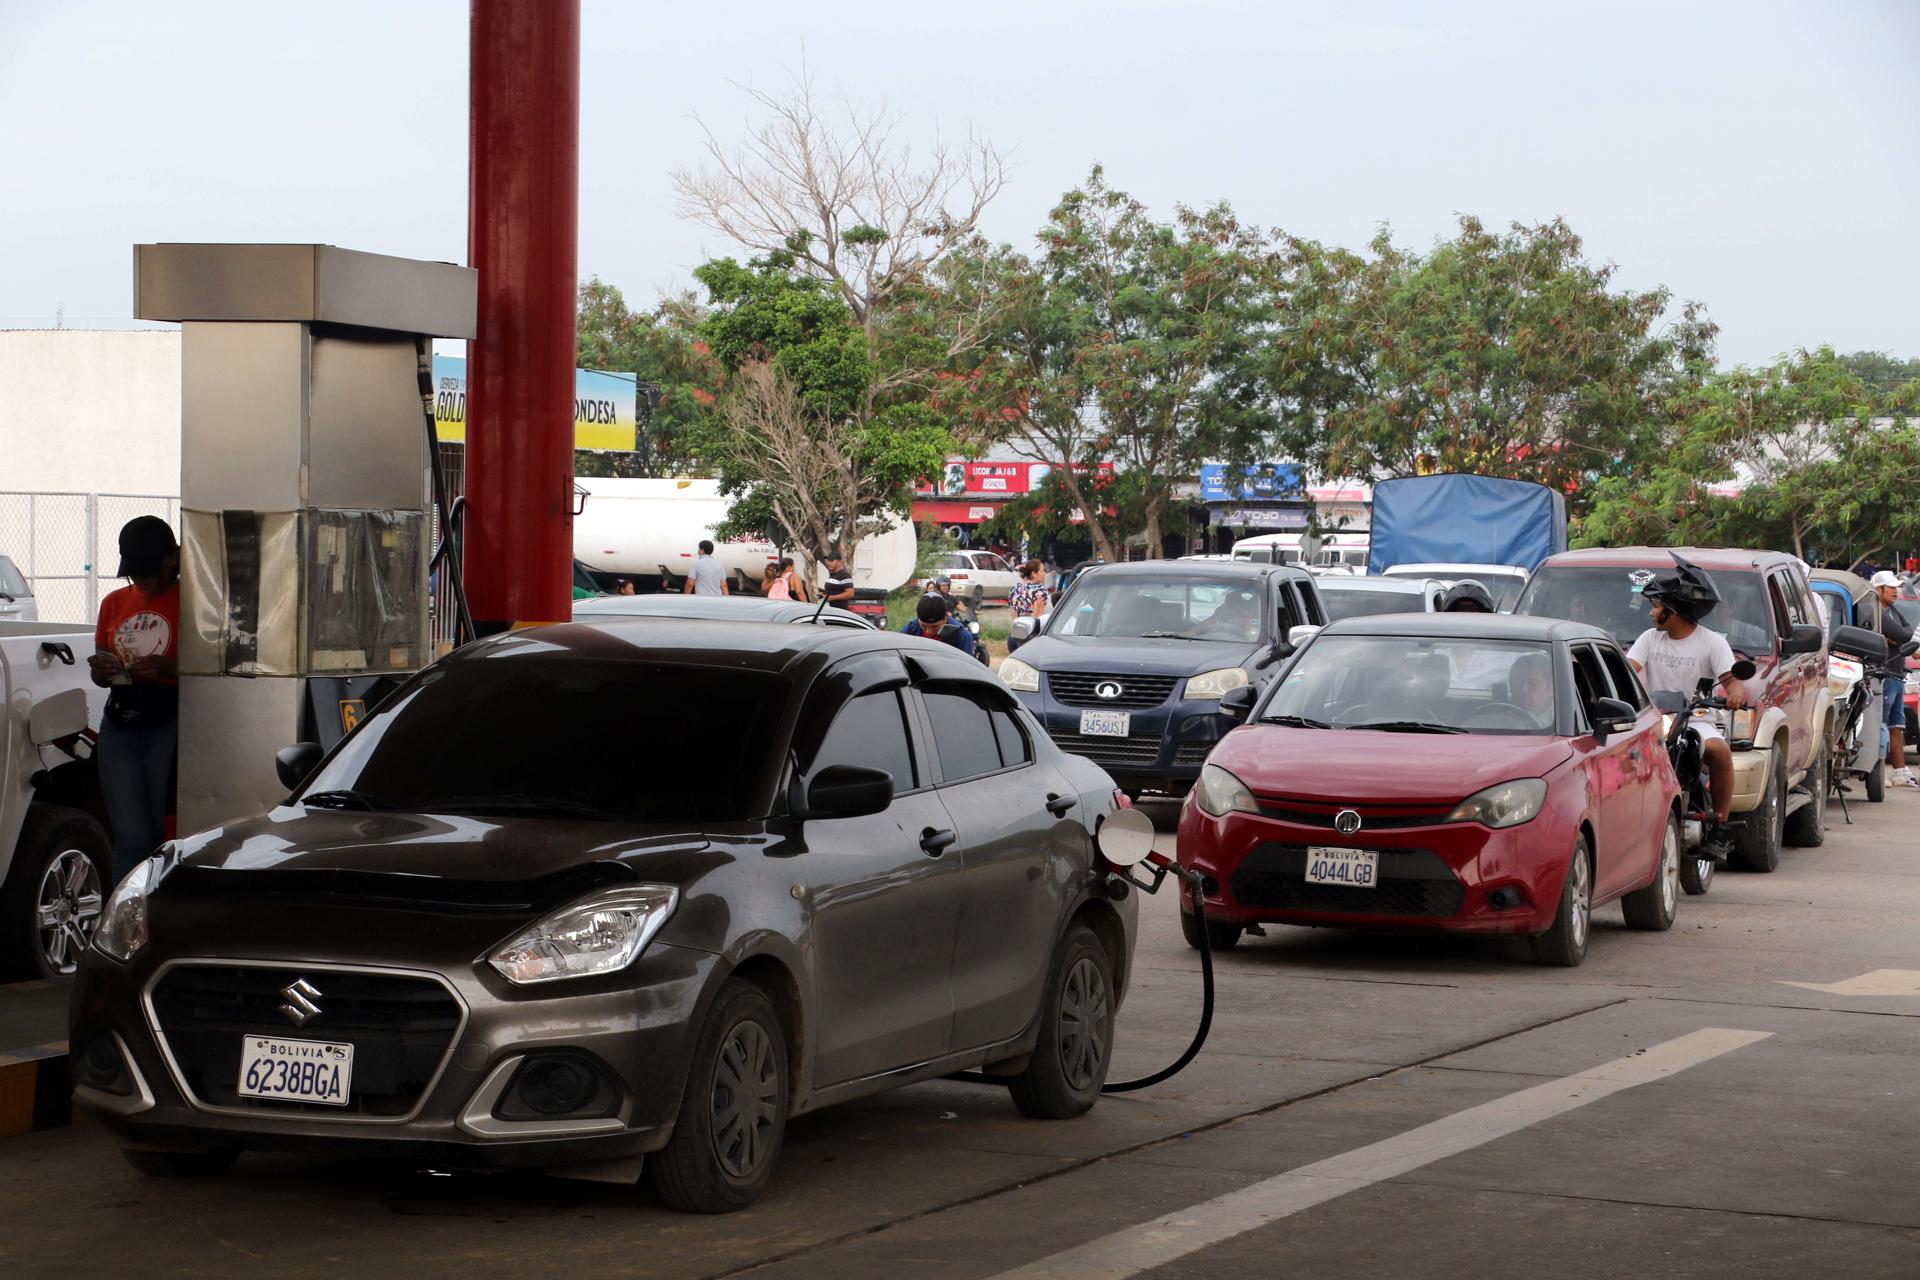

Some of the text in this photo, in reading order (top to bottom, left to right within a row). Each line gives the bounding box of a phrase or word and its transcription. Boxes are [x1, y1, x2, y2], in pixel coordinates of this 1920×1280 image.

[436, 391, 465, 423] GOLD
[1243, 510, 1279, 520] TOYO
[1324, 853, 1360, 861] BOLIVIA
[1310, 860, 1373, 883] 4044LGB
[270, 1044, 324, 1058] BOLIVIA
[246, 1058, 341, 1098] 6238BGA
